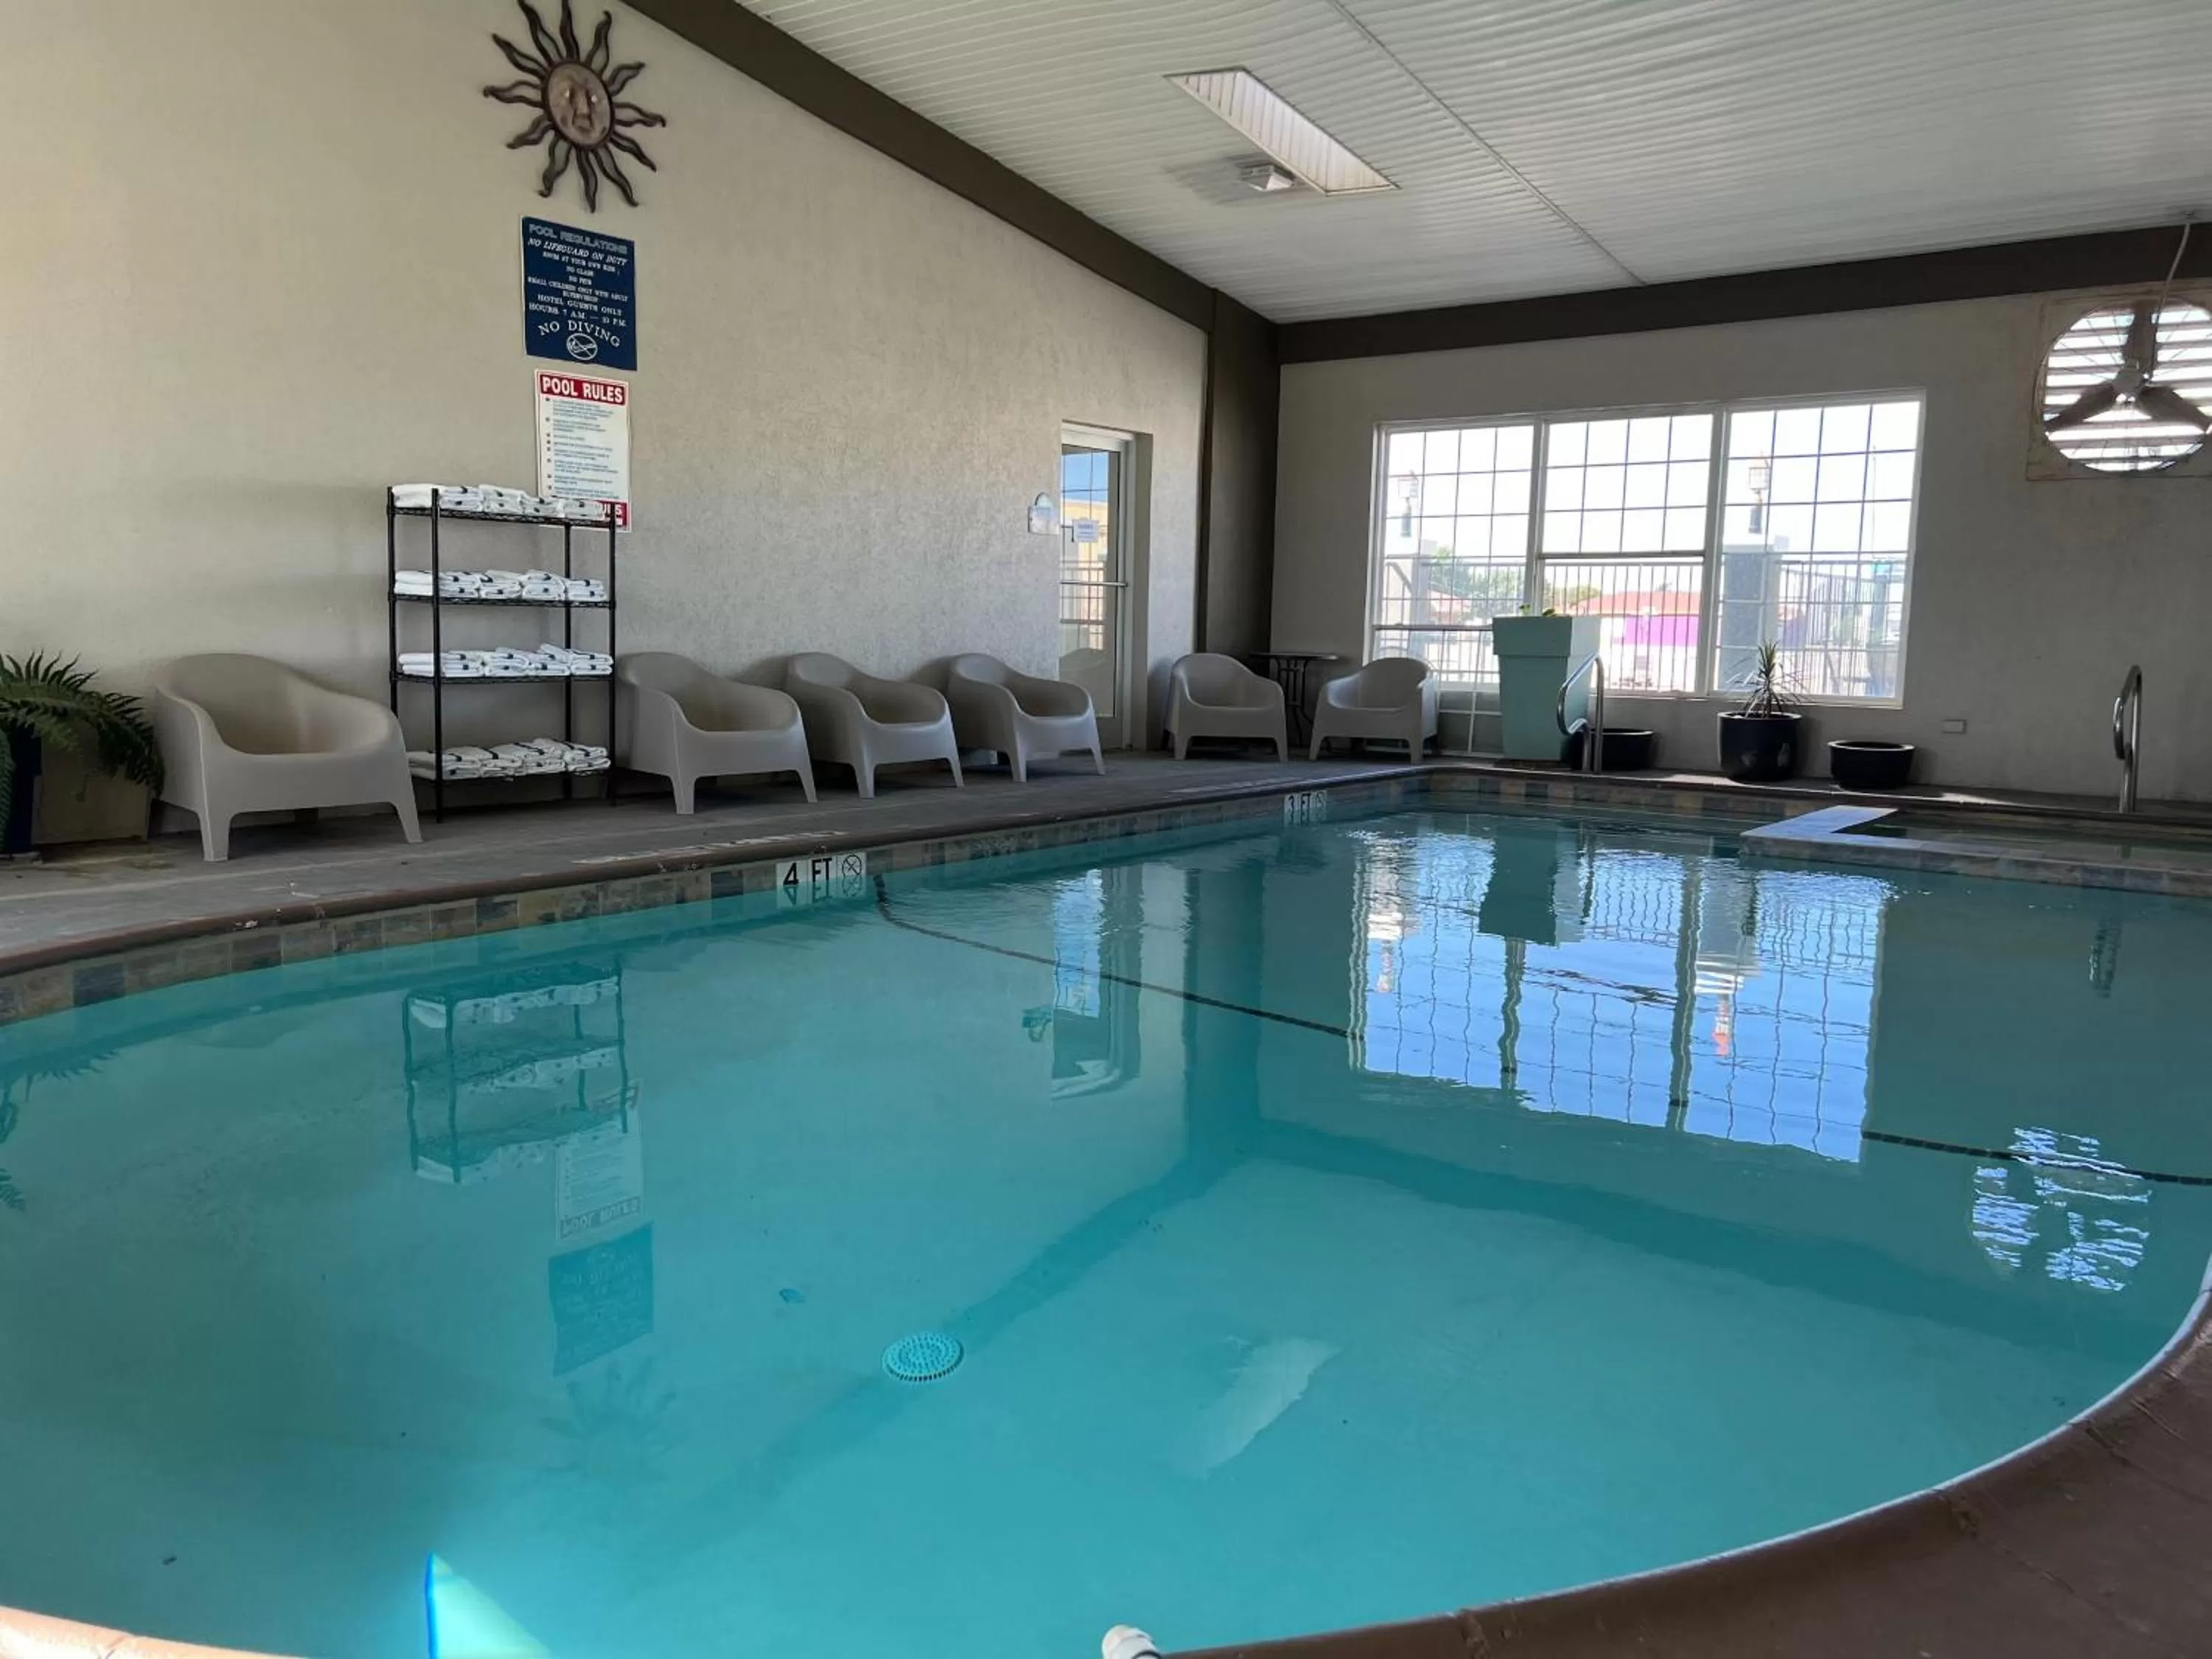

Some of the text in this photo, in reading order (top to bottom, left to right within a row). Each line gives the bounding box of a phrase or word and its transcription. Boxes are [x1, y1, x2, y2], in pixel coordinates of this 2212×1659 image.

[528, 237, 628, 266] NO LIFEGUARD ON DUTY
[529, 224, 627, 255] POOL REGULATIONS
[538, 294, 623, 317] HOTEL GUESTS ONLY
[538, 320, 621, 348] NO DIVING
[542, 376, 624, 403] POOL RULES
[783, 858, 832, 886] 4 FT
